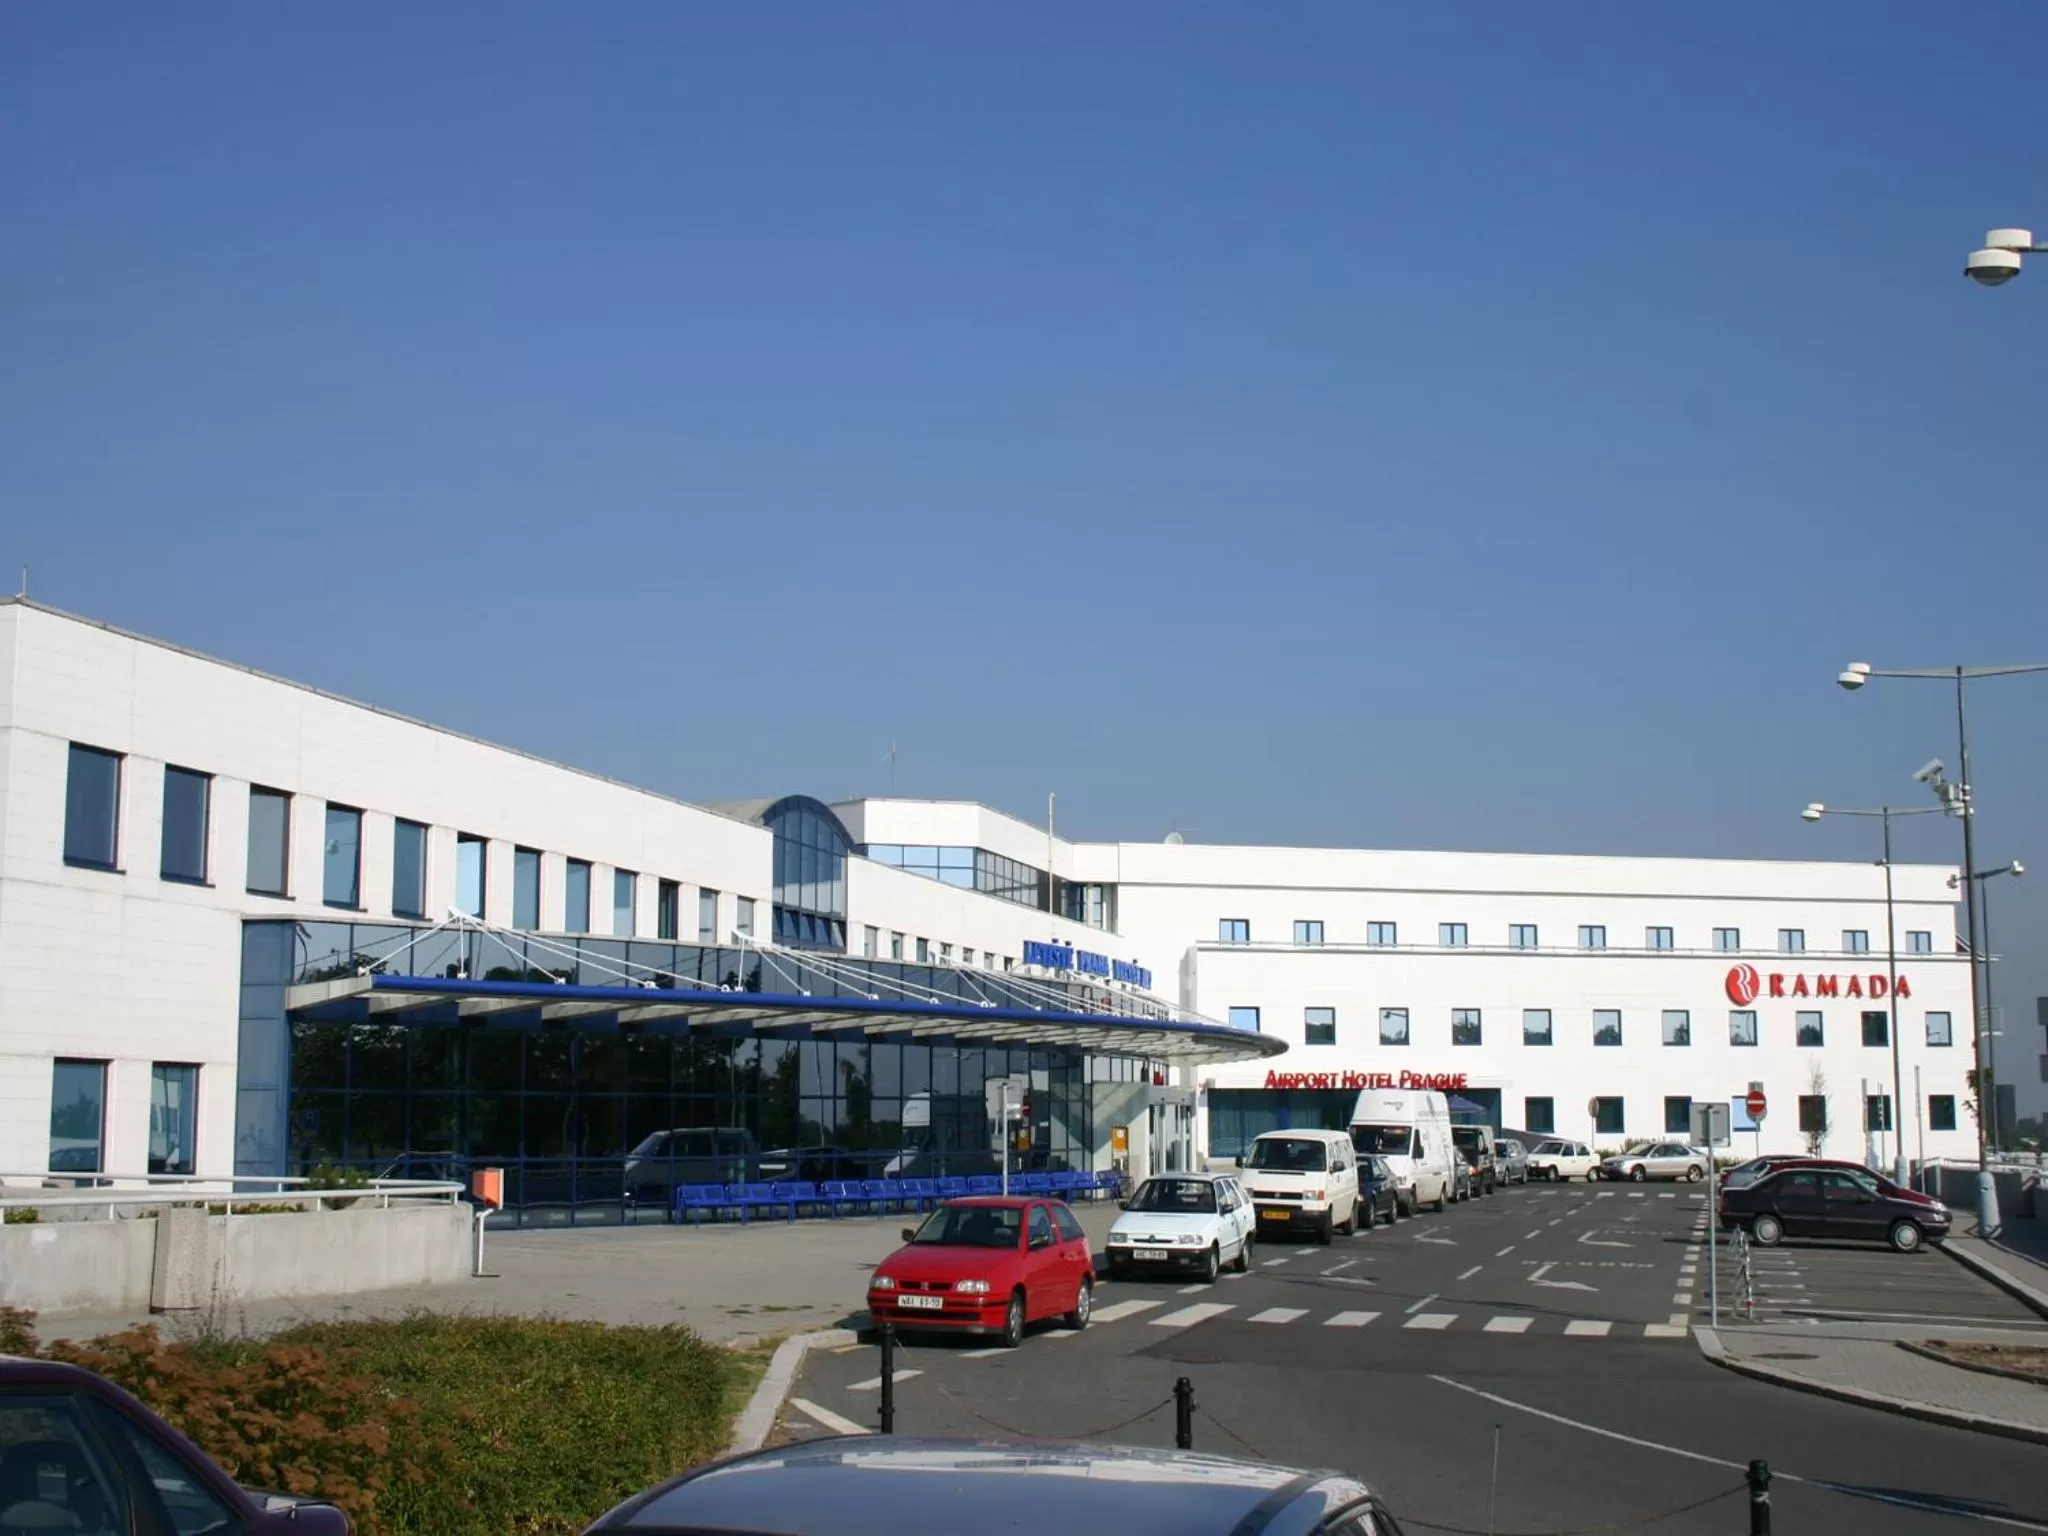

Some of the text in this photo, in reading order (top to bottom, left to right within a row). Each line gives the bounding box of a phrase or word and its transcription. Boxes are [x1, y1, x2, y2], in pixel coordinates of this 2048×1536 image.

[1768, 973, 1911, 999] RAMADA
[1264, 1070, 1468, 1089] AIRPORT HOTEL PRAGUE
